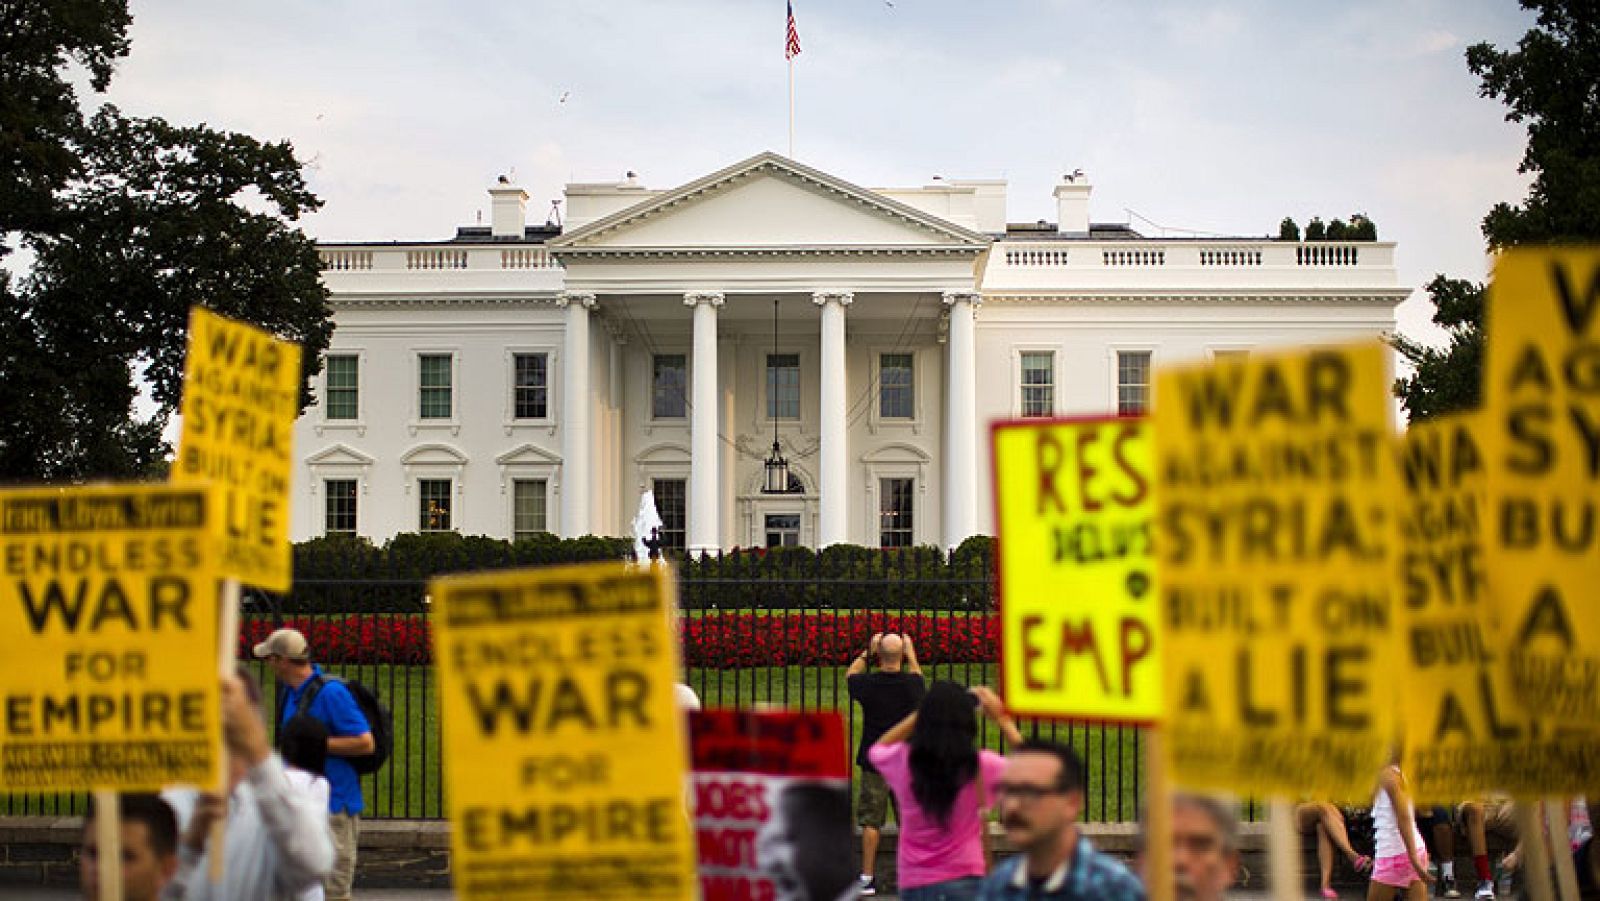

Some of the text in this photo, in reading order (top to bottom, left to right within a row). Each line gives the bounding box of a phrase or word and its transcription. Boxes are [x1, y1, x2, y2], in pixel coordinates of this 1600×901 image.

[208, 323, 281, 375] WAR
[1177, 351, 1354, 431] WAR
[5, 540, 200, 575] ENDLESS
[18, 575, 192, 634] WAR
[1165, 583, 1389, 635] BUILT ON
[65, 651, 147, 682] FOR
[452, 624, 658, 672] ENDLESS
[7, 689, 207, 736] EMPIRE
[465, 668, 650, 737] WAR
[1180, 645, 1371, 730] A LIE
[521, 753, 609, 791] FOR
[462, 799, 674, 851] EMPIRE
